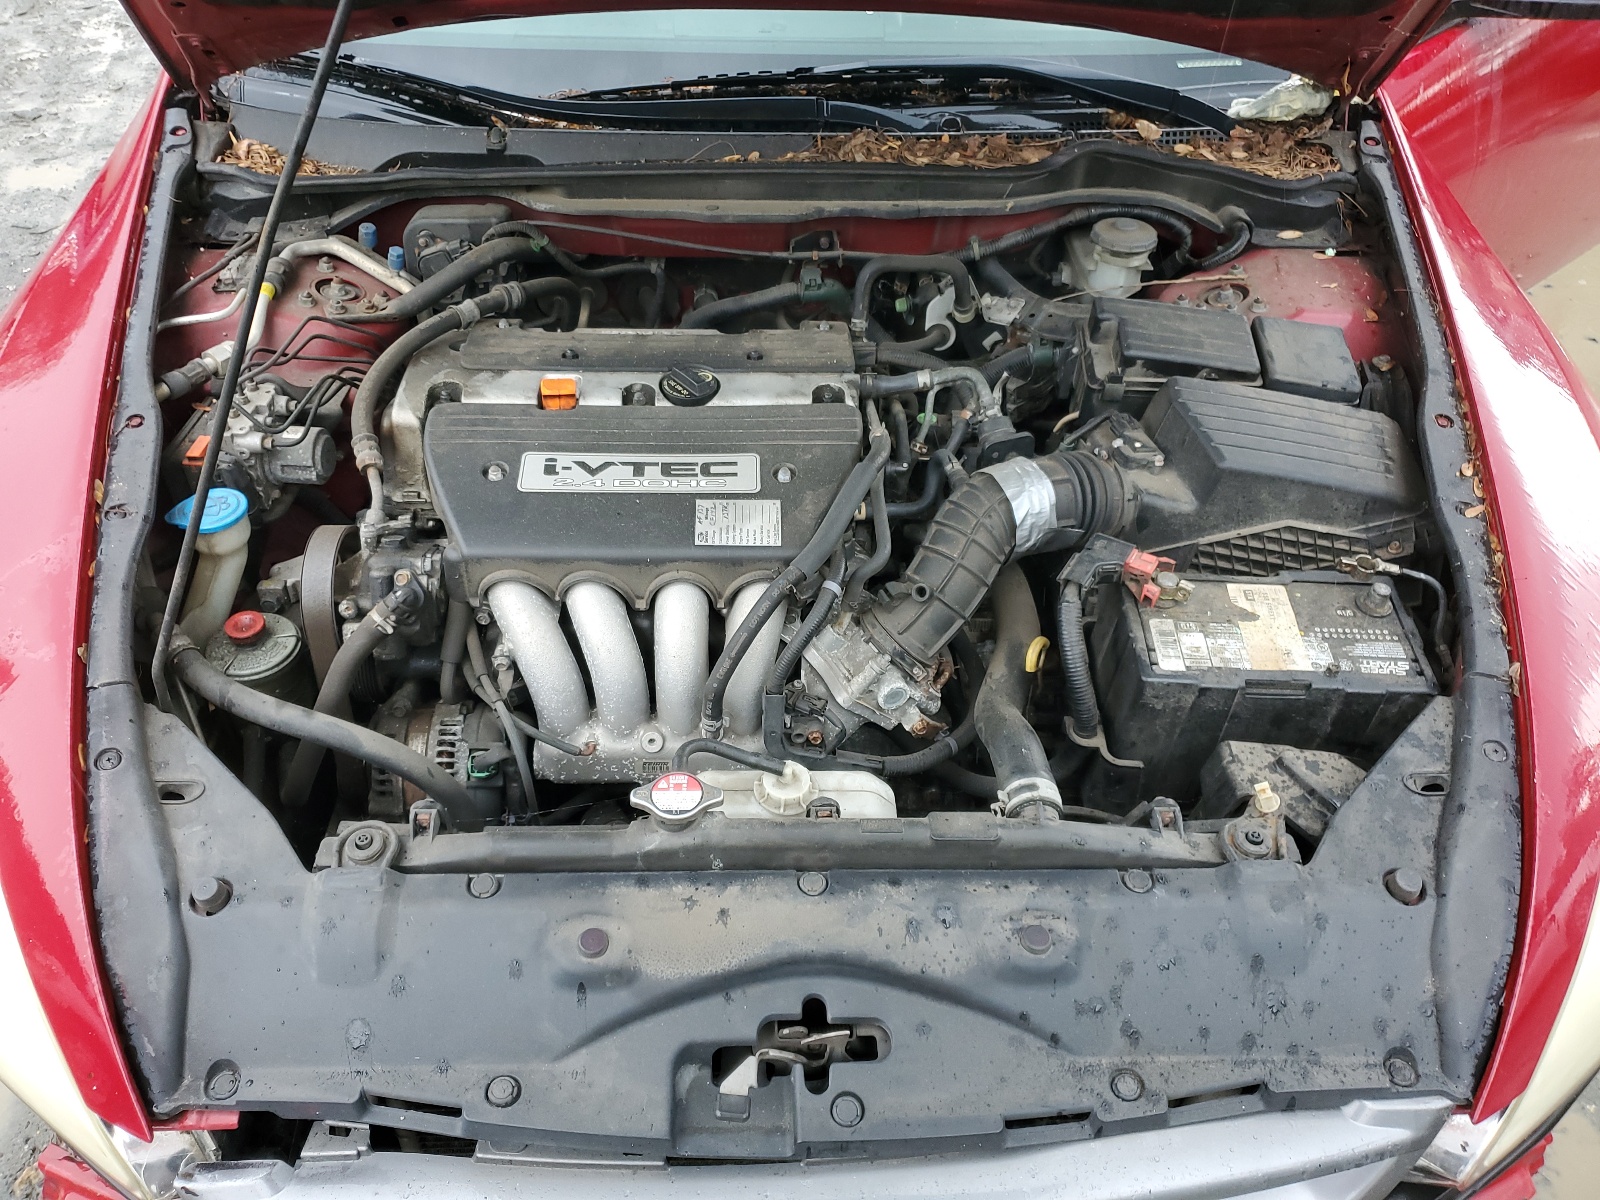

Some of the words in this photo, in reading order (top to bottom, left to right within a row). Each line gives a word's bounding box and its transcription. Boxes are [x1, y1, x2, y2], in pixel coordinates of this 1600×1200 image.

[543, 457, 738, 478] i-VTEC
[552, 477, 606, 488] 2.4
[612, 478, 727, 488] DOHC
[1359, 659, 1410, 669] START
[1361, 666, 1406, 676] SUPER
